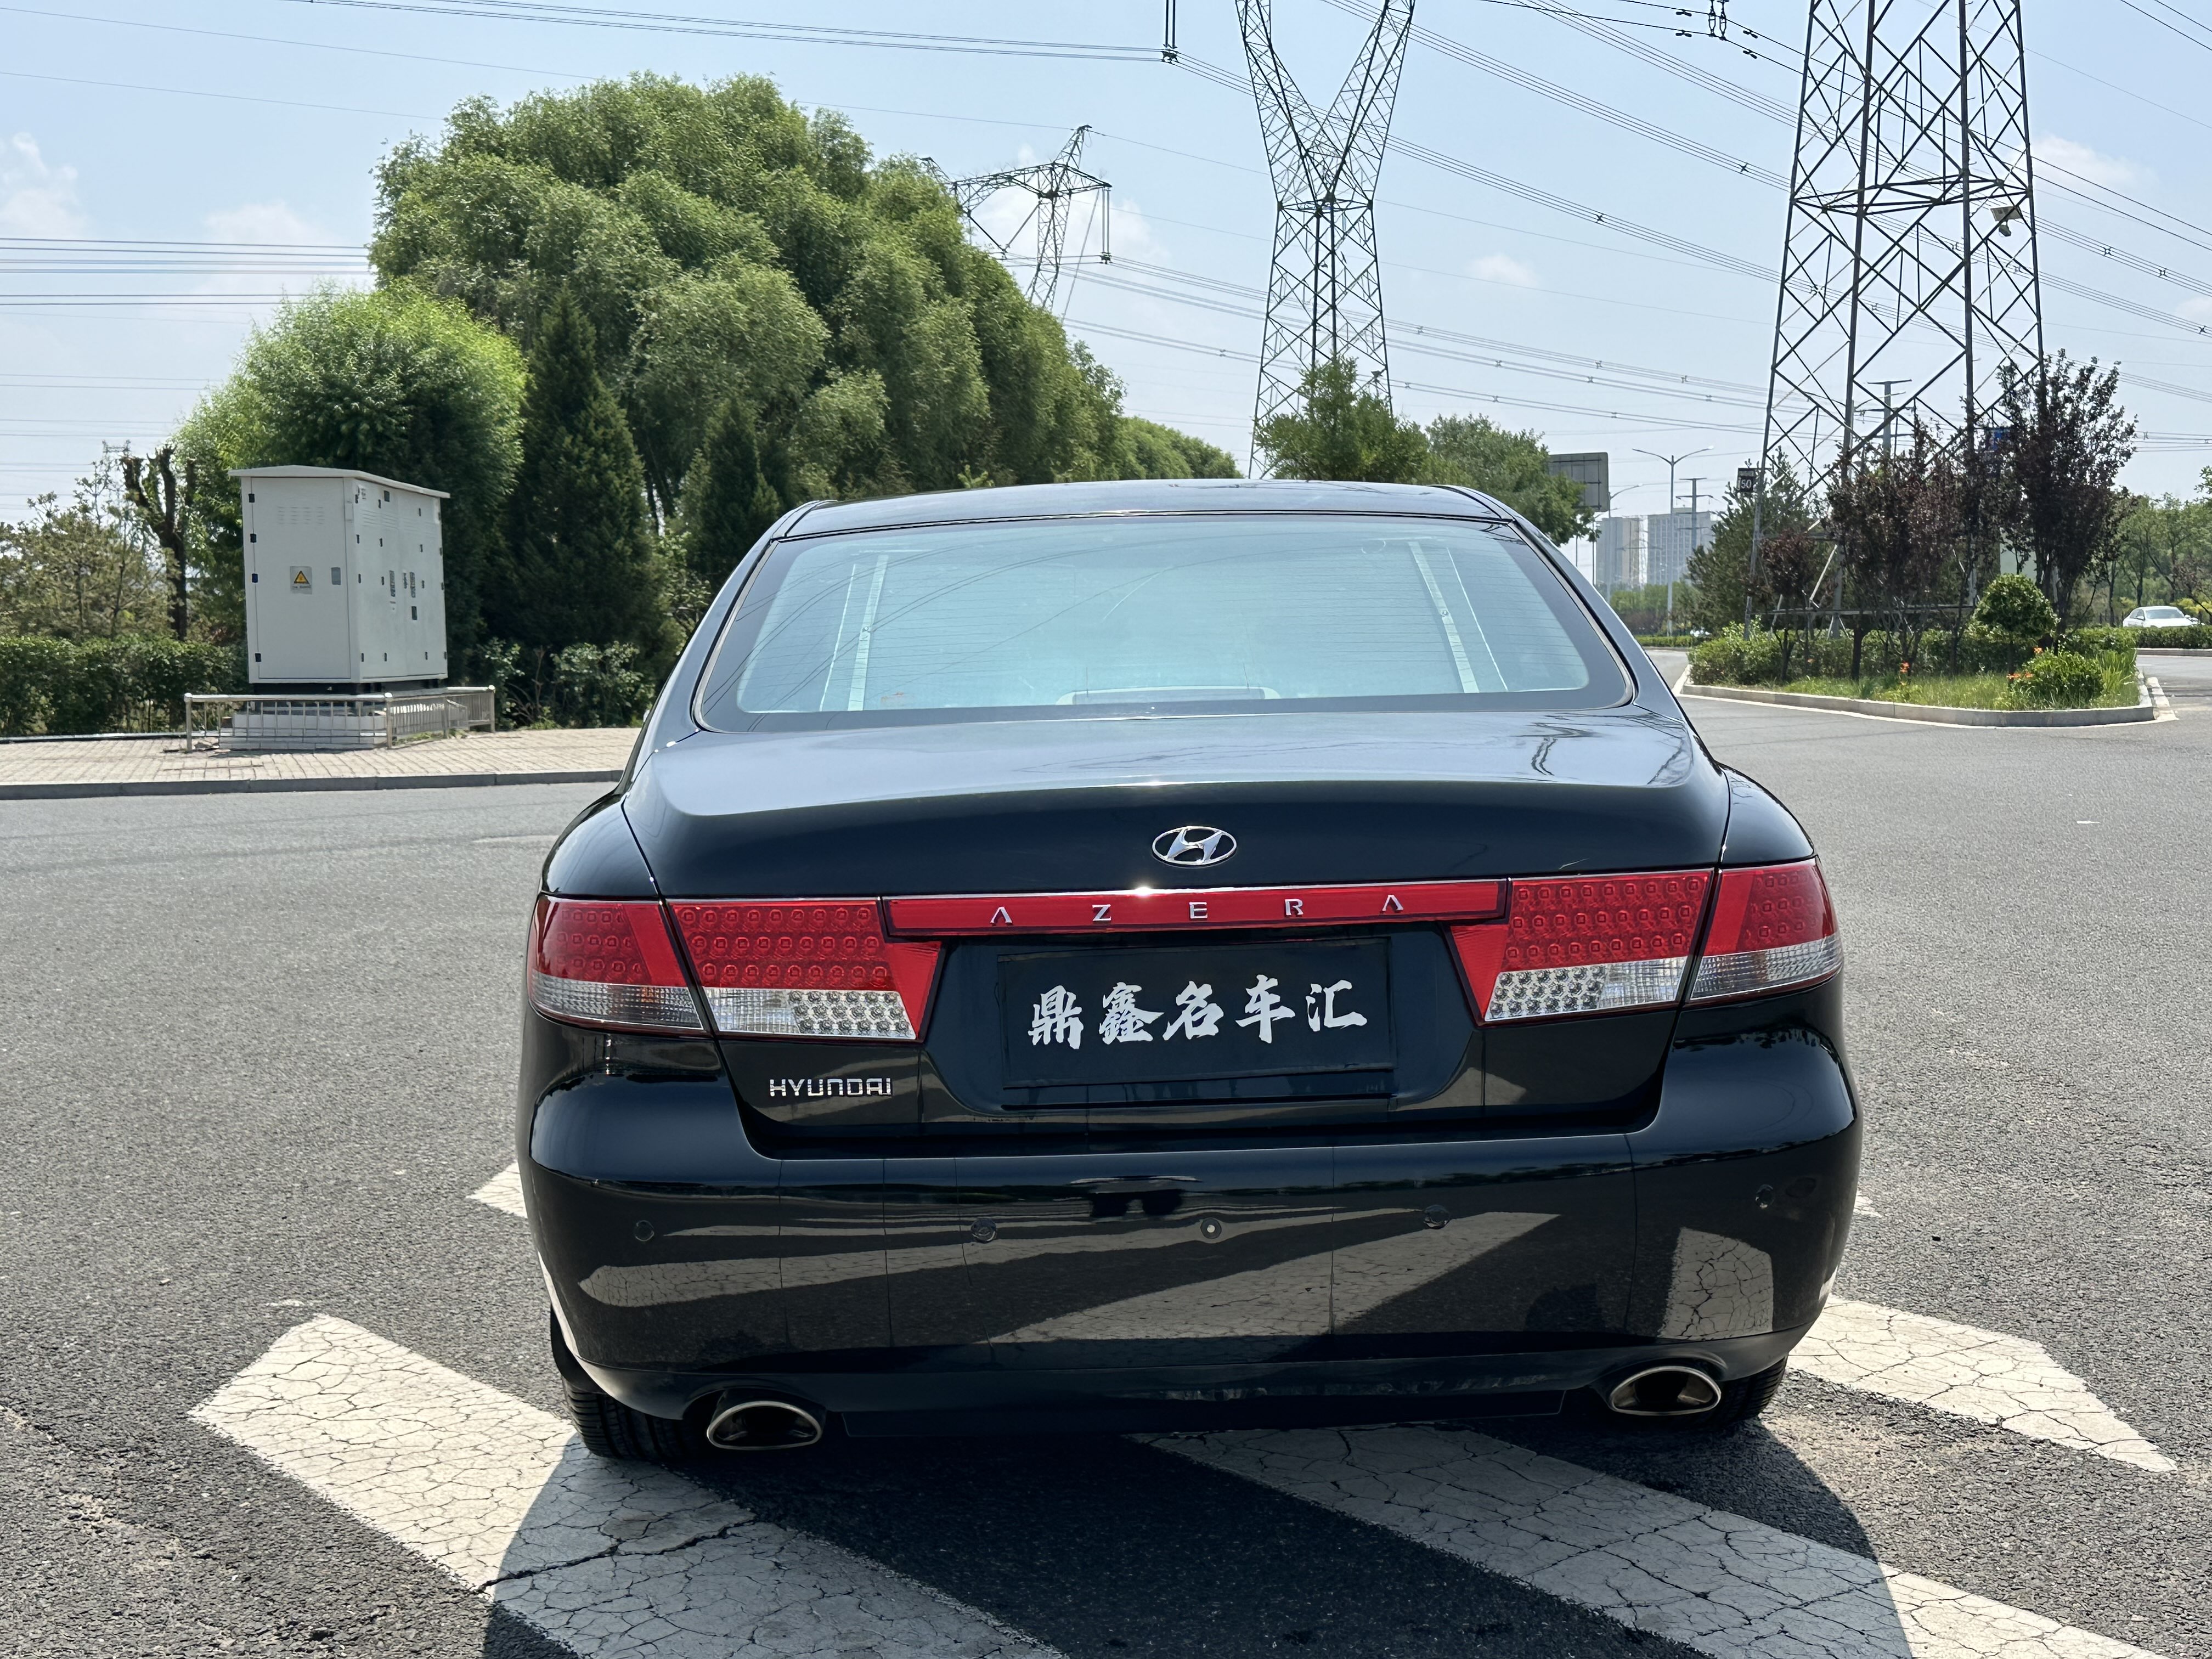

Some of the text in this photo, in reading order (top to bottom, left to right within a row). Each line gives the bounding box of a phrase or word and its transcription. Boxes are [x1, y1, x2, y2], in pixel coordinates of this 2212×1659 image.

[990, 894, 1403, 926] AZERA
[1028, 974, 1367, 1049] 鼎鑫名车汇
[770, 1077, 891, 1097] HYUNDAI
